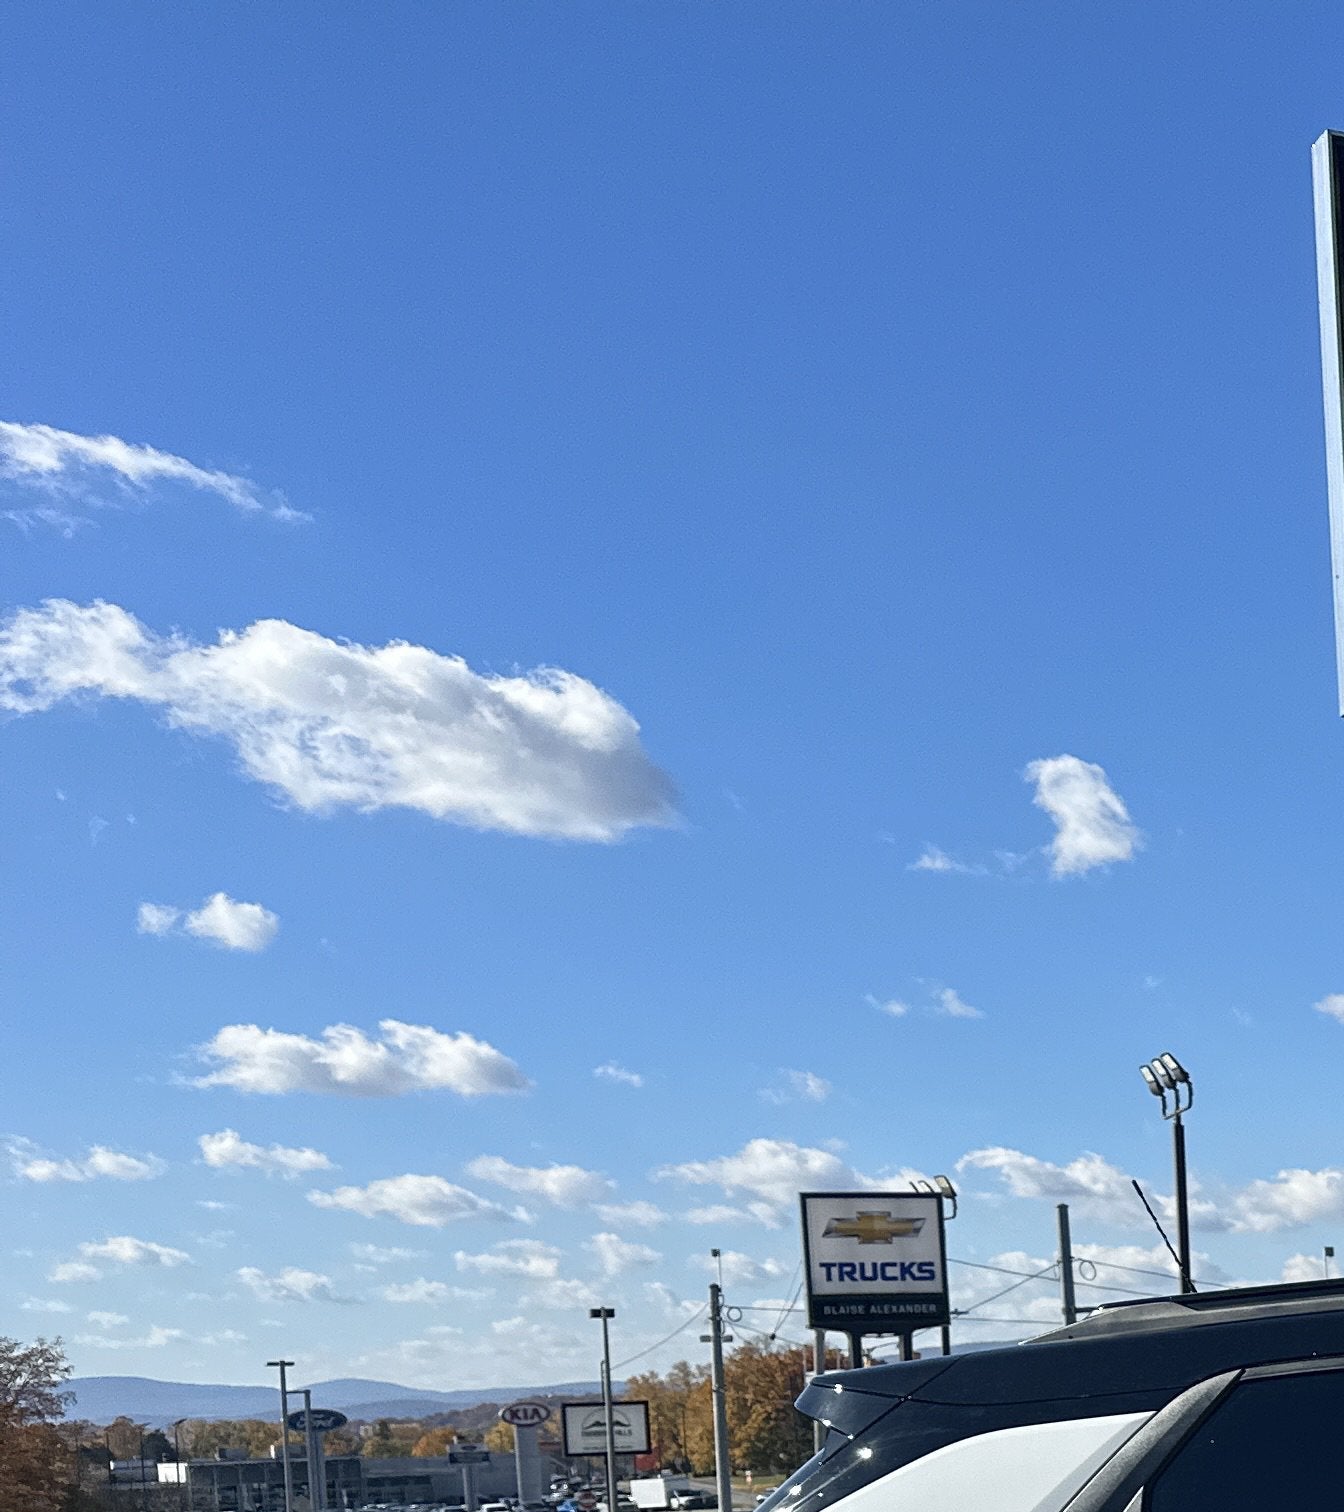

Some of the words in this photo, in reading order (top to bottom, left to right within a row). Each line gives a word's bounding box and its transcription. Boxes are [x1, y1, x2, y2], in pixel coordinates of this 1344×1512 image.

[819, 1261, 936, 1282] TRUCKS
[824, 1305, 866, 1316] BLAISE
[869, 1303, 937, 1315] ALEXANDER
[511, 1407, 541, 1420] KIA
